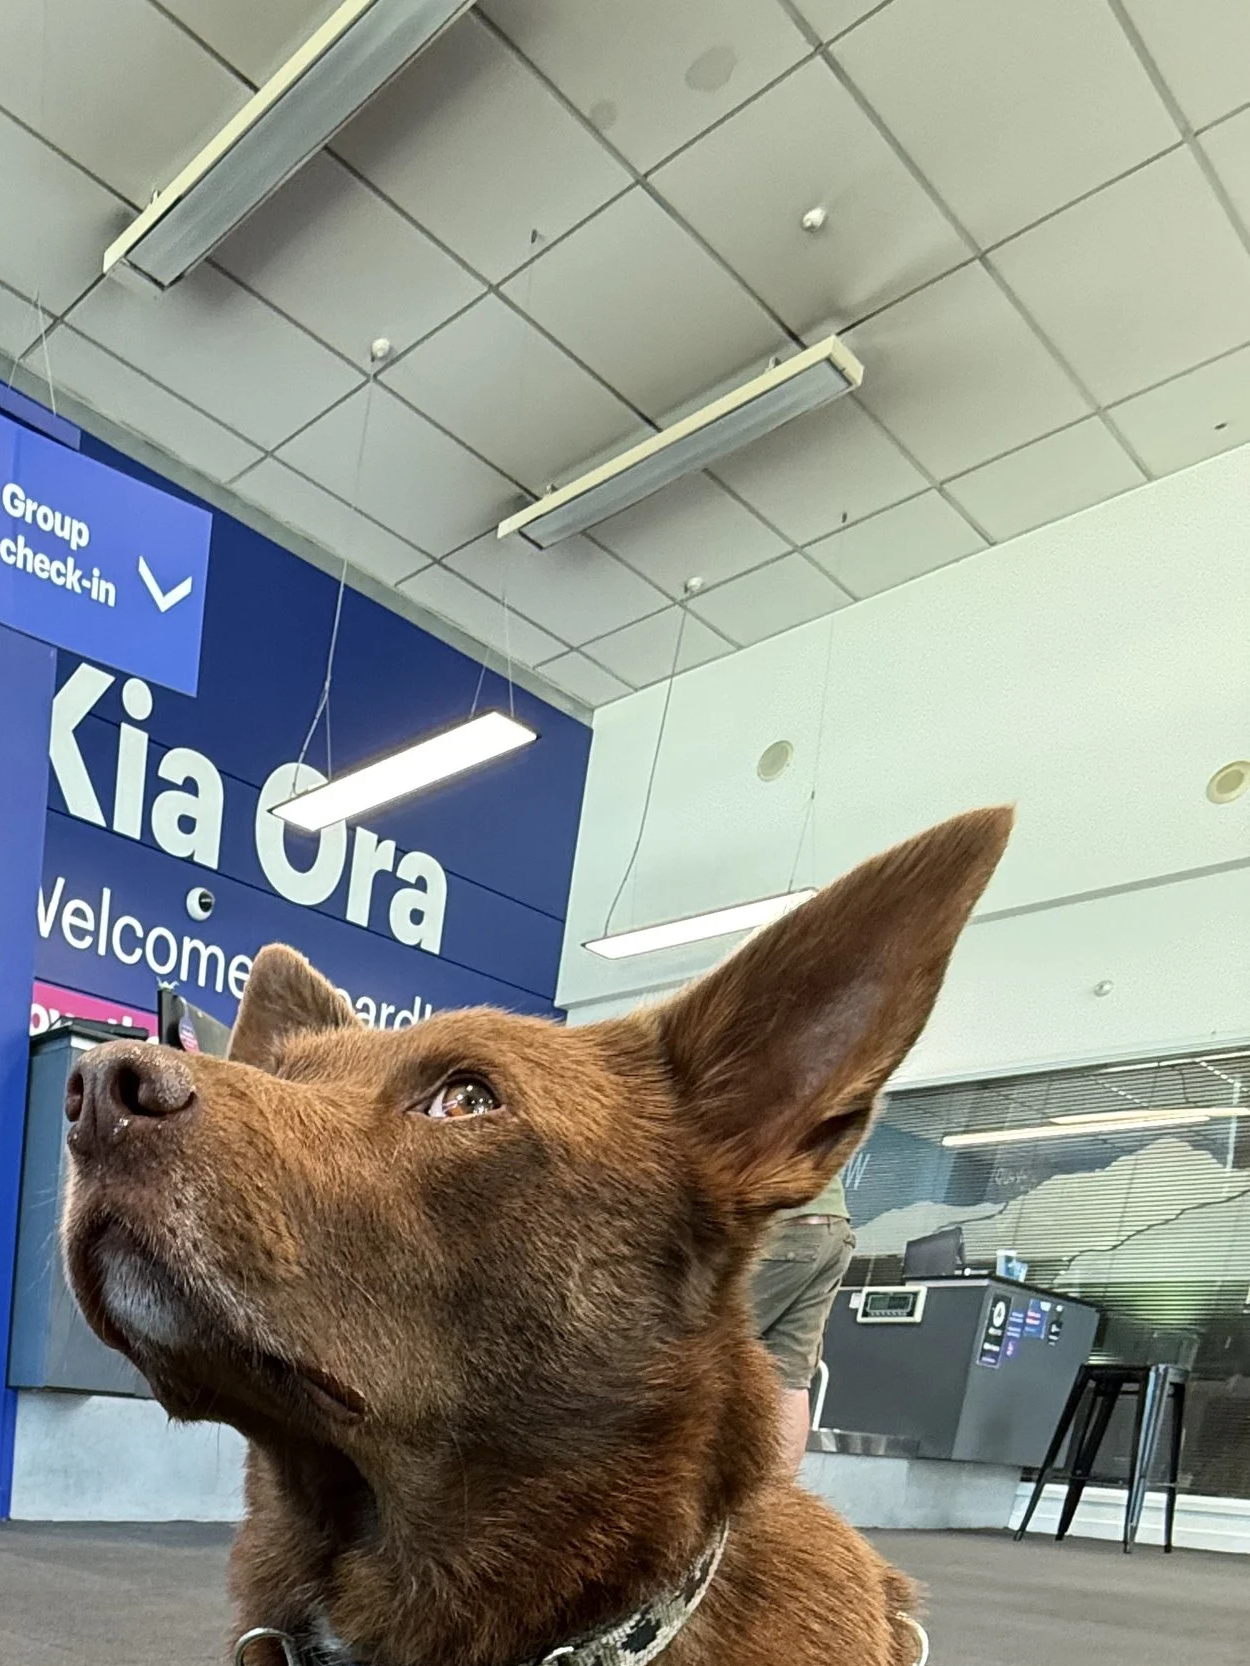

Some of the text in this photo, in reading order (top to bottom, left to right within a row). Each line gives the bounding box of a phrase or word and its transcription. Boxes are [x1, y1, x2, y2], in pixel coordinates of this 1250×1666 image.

[2, 482, 90, 551] Group
[0, 534, 116, 607] check-in
[49, 662, 224, 869] Kia
[255, 762, 448, 954] Ora
